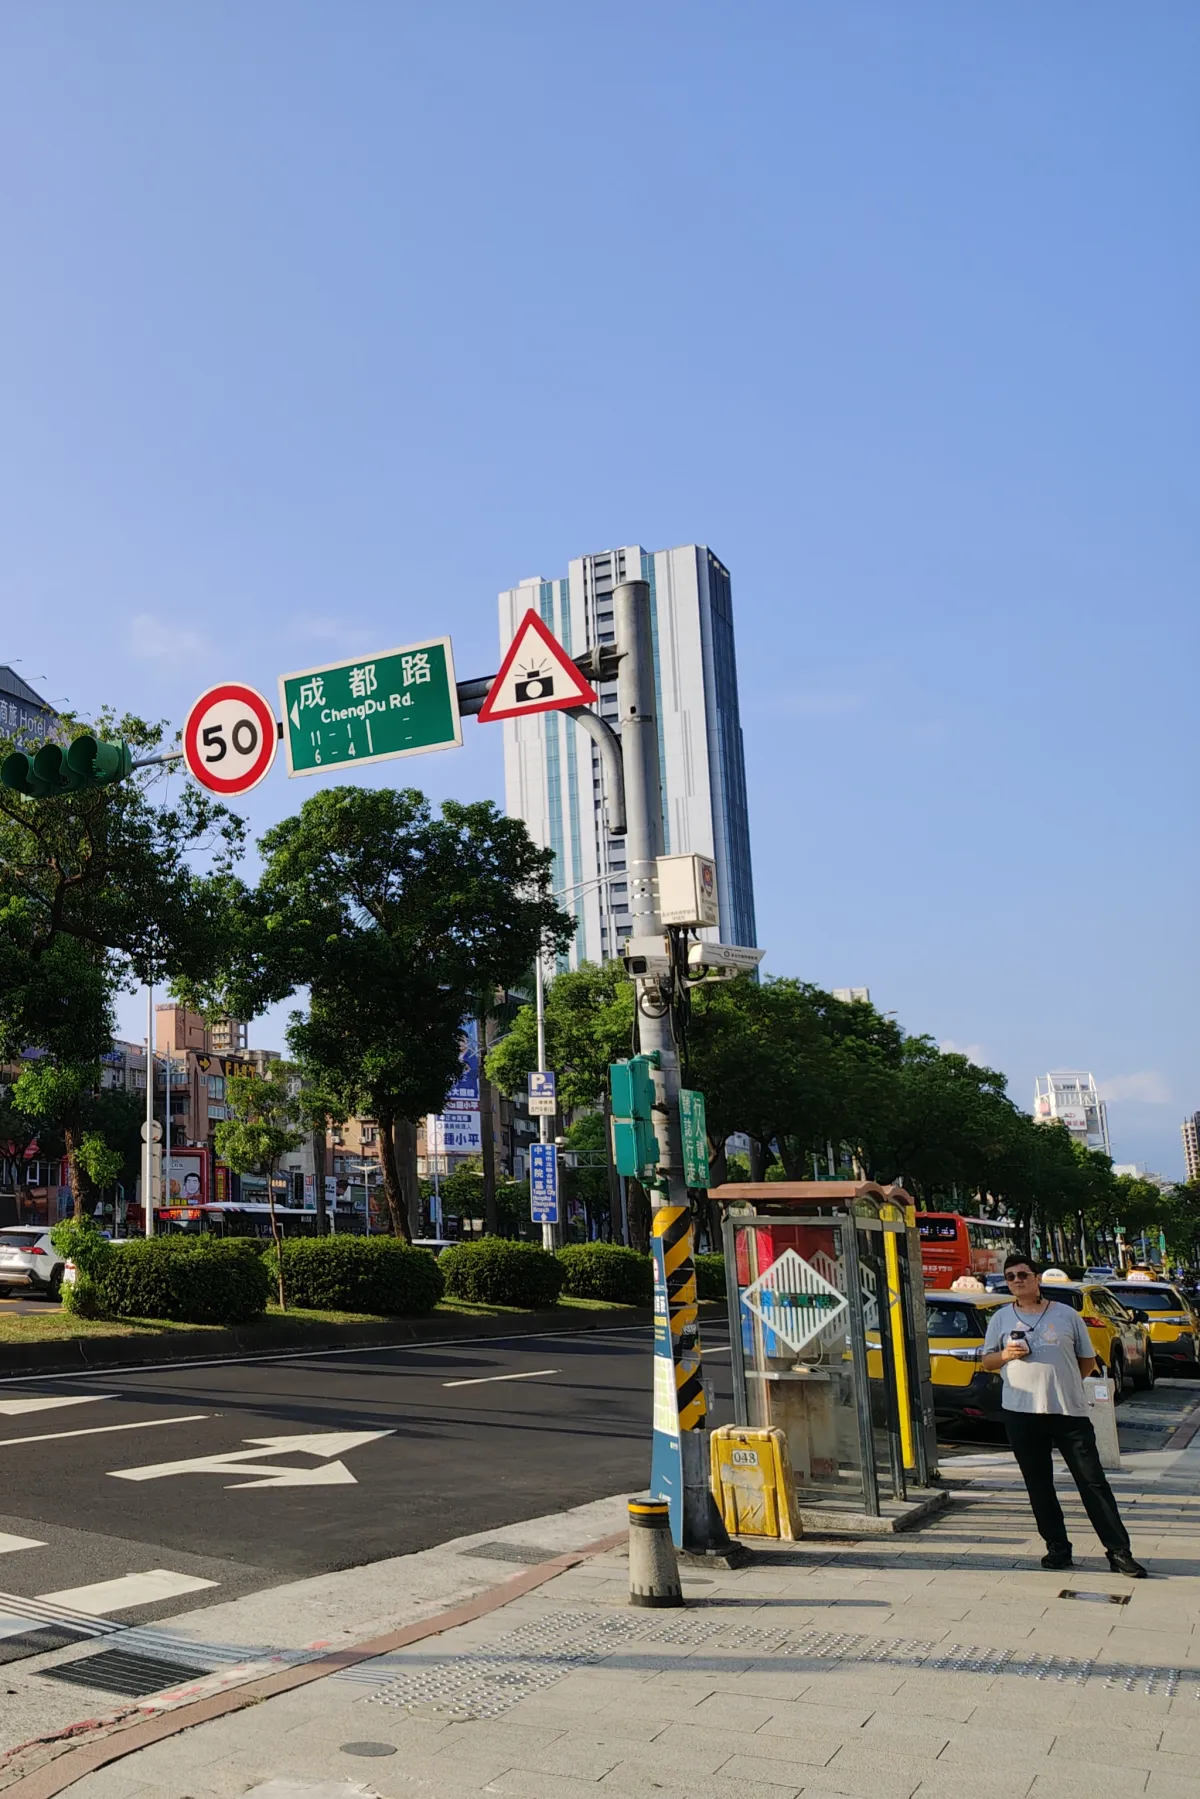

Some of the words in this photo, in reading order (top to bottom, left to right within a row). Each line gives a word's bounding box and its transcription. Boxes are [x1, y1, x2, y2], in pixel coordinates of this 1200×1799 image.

[299, 653, 431, 711] 成都路
[19, 708, 46, 736] Hotel
[320, 700, 386, 724] ChengDu
[389, 692, 414, 709] Rd.
[202, 718, 258, 763] 50
[314, 749, 321, 764] 6
[348, 742, 356, 756] 4
[531, 1074, 545, 1090] P
[443, 1132, 479, 1146] 鍾小平
[682, 1096, 696, 1183] 號誌行走
[693, 1098, 706, 1179] 行人請依
[533, 1145, 543, 1189] 中興院區
[733, 1451, 755, 1464] 048
